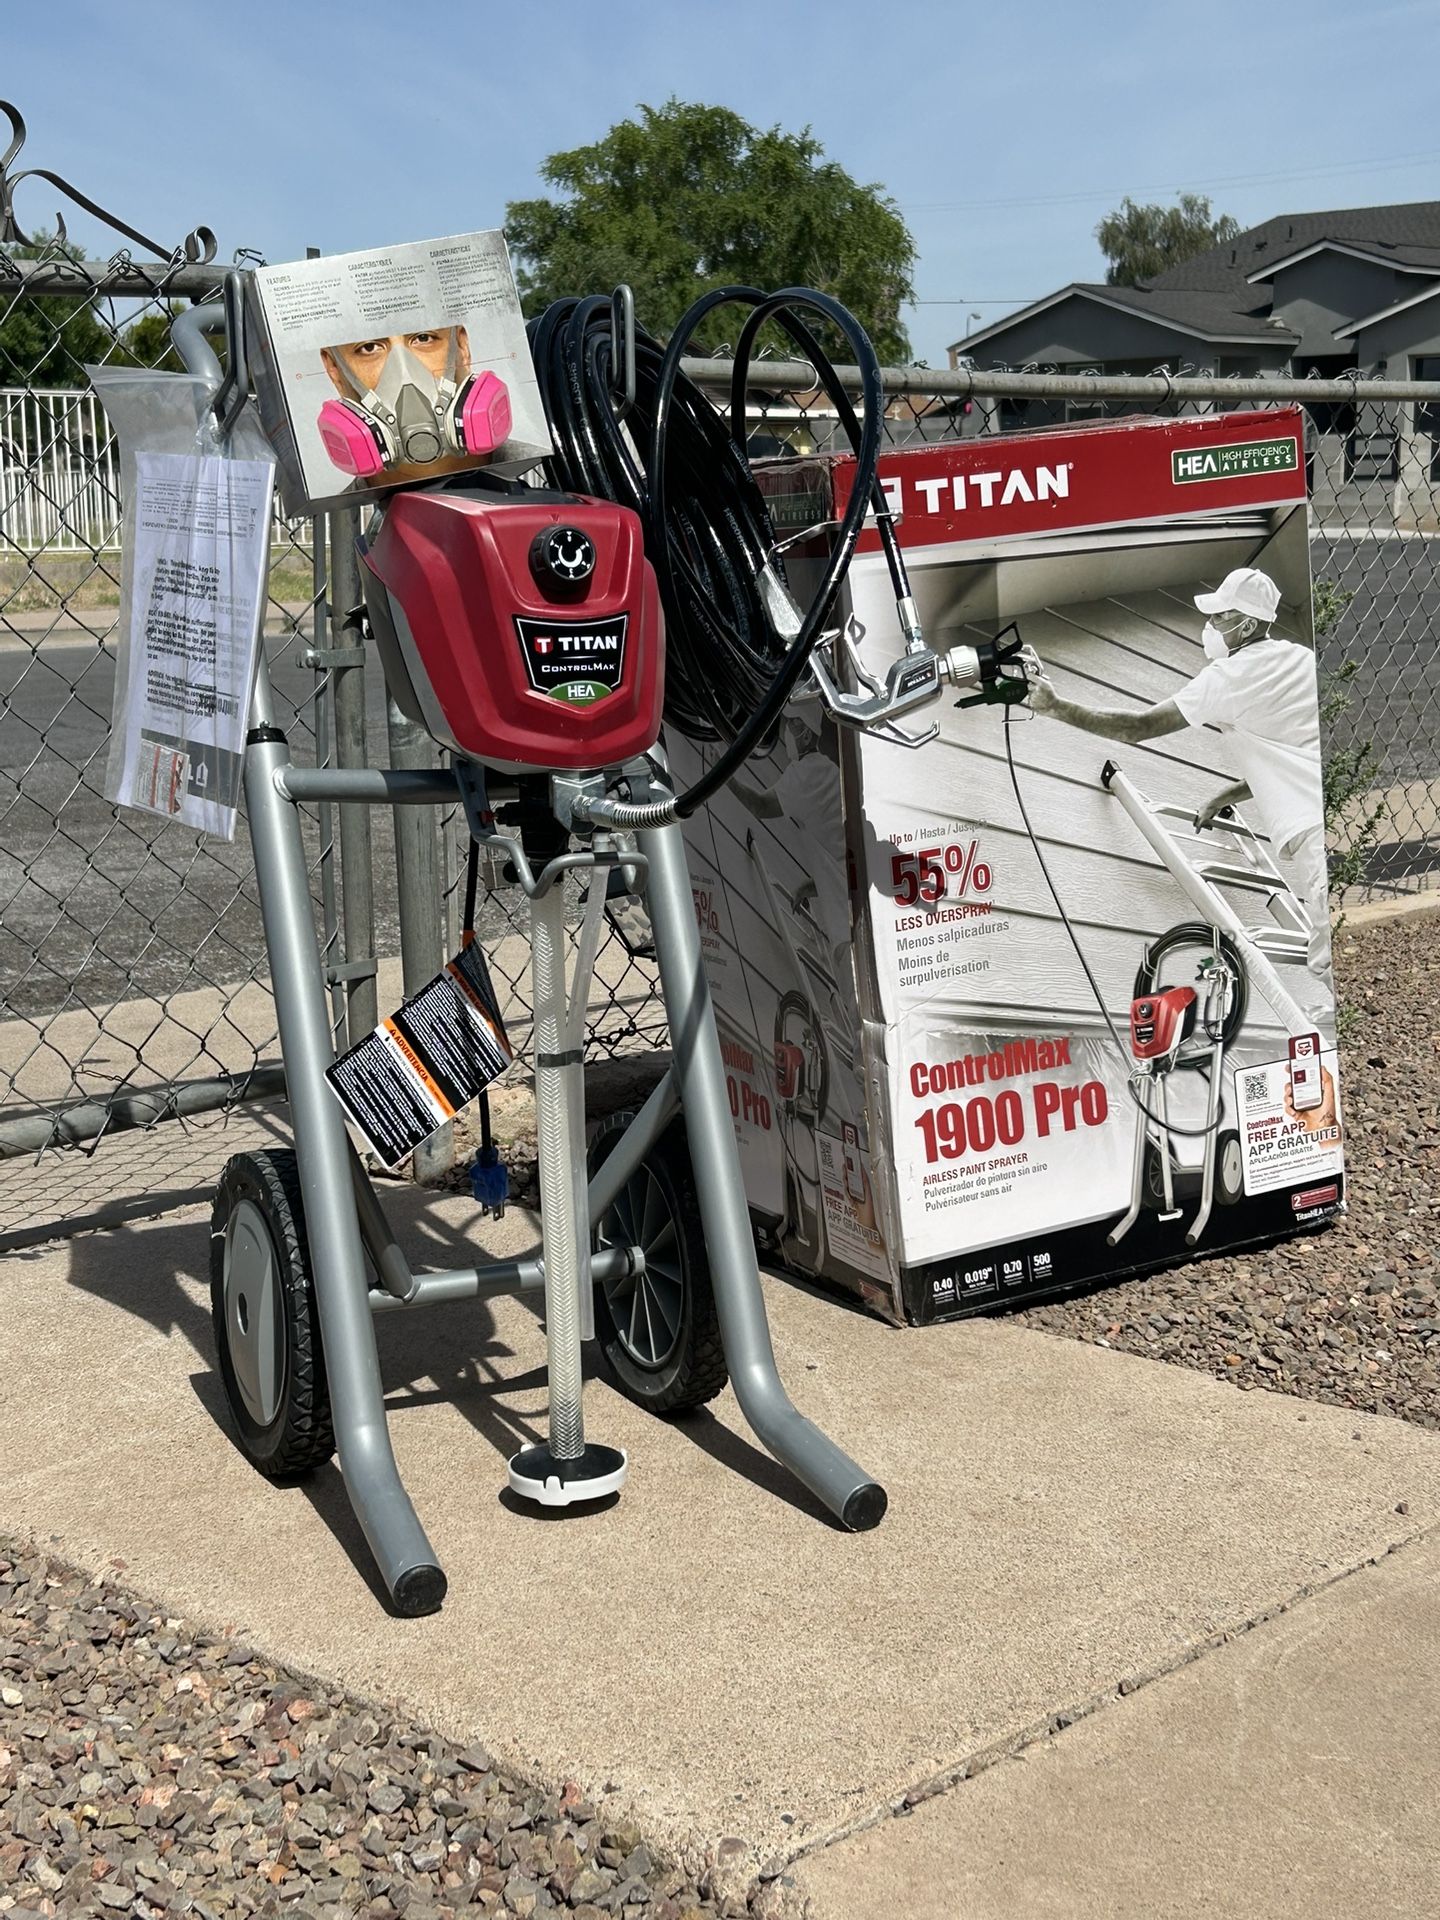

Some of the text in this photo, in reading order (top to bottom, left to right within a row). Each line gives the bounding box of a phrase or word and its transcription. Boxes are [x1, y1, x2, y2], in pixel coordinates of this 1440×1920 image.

[1221, 445, 1291, 461] HIGH EFFICIENCY
[1222, 454, 1292, 471] AIRLESS
[1178, 454, 1218, 476] HEA
[914, 463, 1070, 514] TITAN
[558, 635, 618, 651] TITAN
[567, 684, 596, 698] HEA
[889, 834, 902, 846] Up
[904, 833, 913, 843] to
[920, 827, 946, 839] Hasta
[891, 839, 992, 907] 55%
[895, 915, 923, 932] LESS
[897, 920, 1010, 952] Menos salpicaduras
[898, 950, 950, 971] Moins de
[910, 1036, 1072, 1098] ControlMax
[741, 1080, 771, 1130] Pro
[914, 1081, 1108, 1163] 1900 Pro
[1246, 1116, 1283, 1131] ControlMax
[1247, 1121, 1306, 1144] FREE APP
[1249, 1127, 1337, 1158] APP GRATUITE
[923, 1152, 1029, 1187] AIRLESS PAINT SPRAYER
[924, 1180, 975, 1199] Pulverizador
[988, 1169, 1017, 1186] pintura
[1018, 1165, 1030, 1176] sin
[1031, 1162, 1048, 1173] aire
[980, 1187, 1000, 1199] sans
[1001, 1182, 1013, 1194] air
[1293, 1195, 1302, 1207] 2
[1003, 1259, 1023, 1274] 0.70
[1033, 1252, 1051, 1266] 500
[933, 1277, 953, 1292] 0.40
